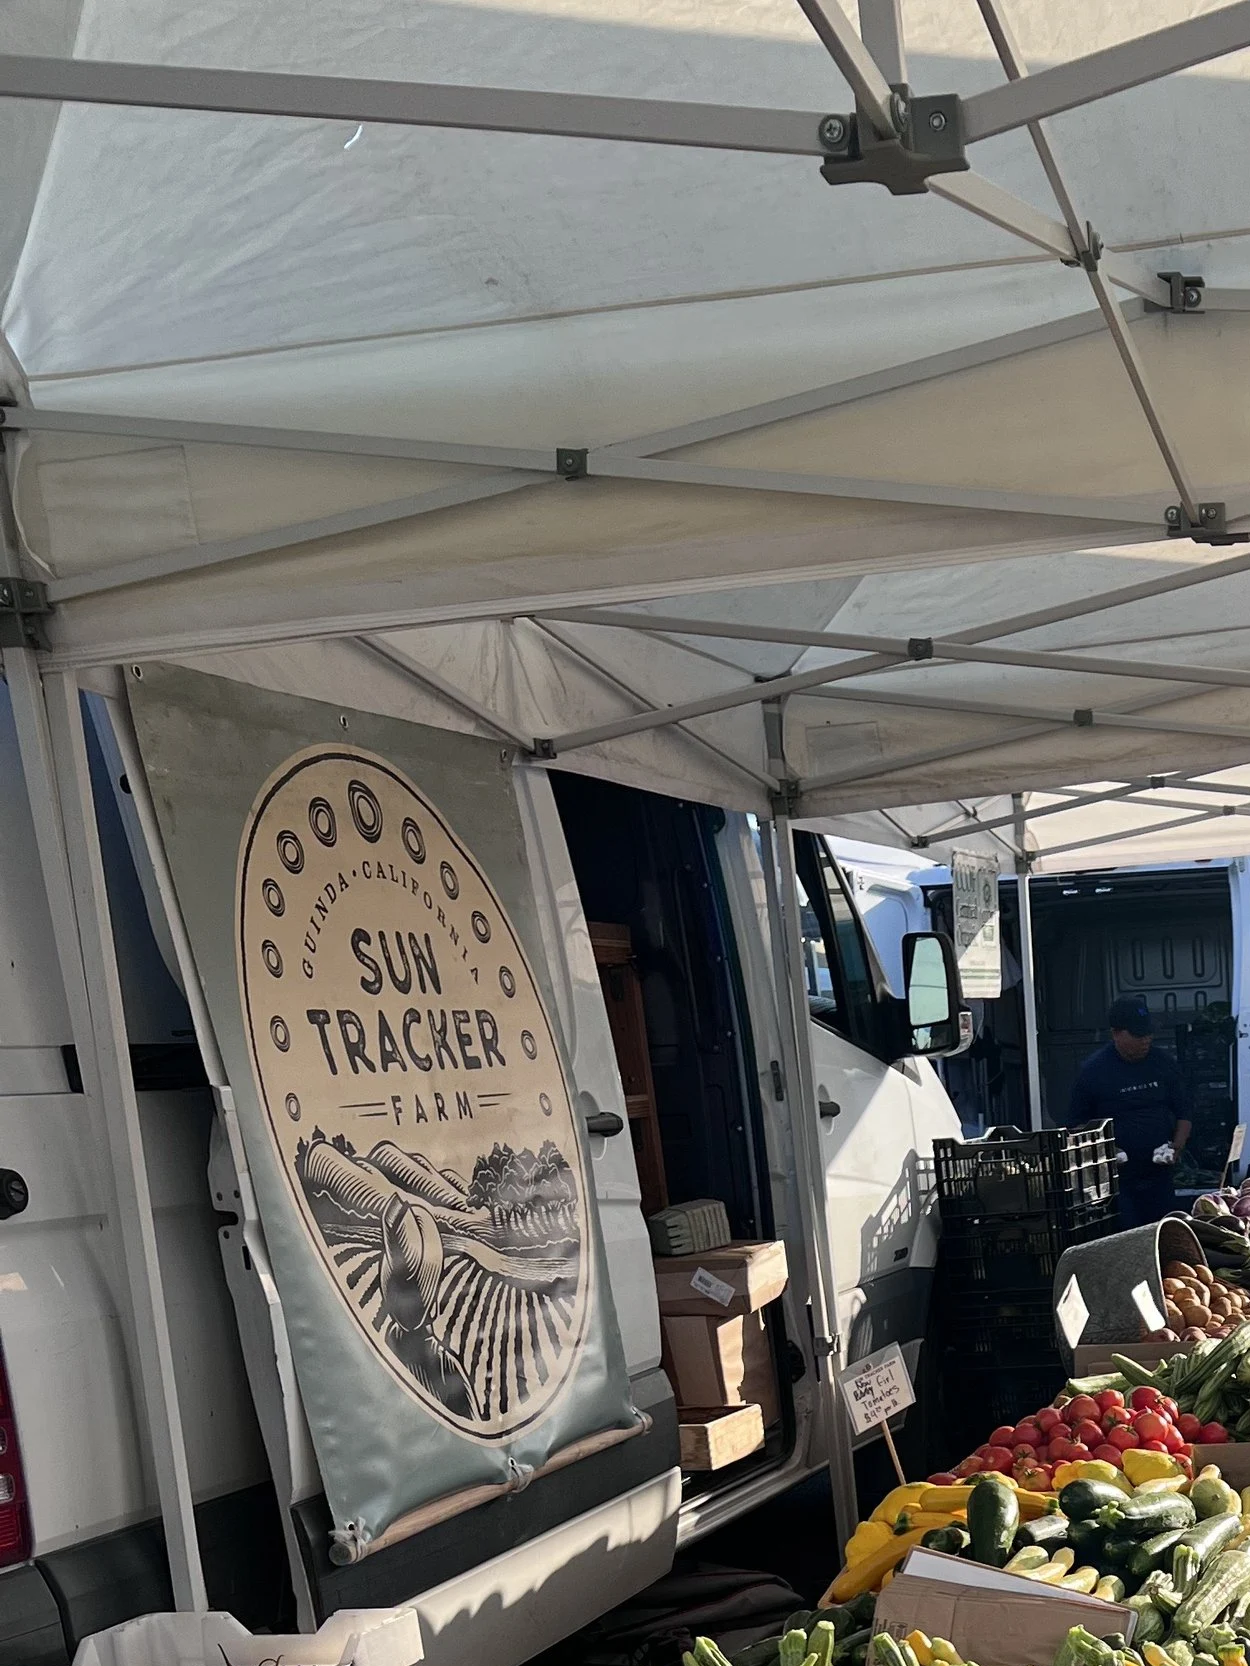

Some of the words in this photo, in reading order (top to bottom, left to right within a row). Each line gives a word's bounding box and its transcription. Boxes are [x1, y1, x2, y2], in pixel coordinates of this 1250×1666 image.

[302, 871, 349, 979] GUINDA
[362, 860, 480, 985] CALIFORNIA
[351, 928, 442, 995] SUN
[306, 1008, 506, 1075] TRACKER
[391, 1091, 473, 1125] FARM
[861, 1385, 900, 1411] Tomatoes
